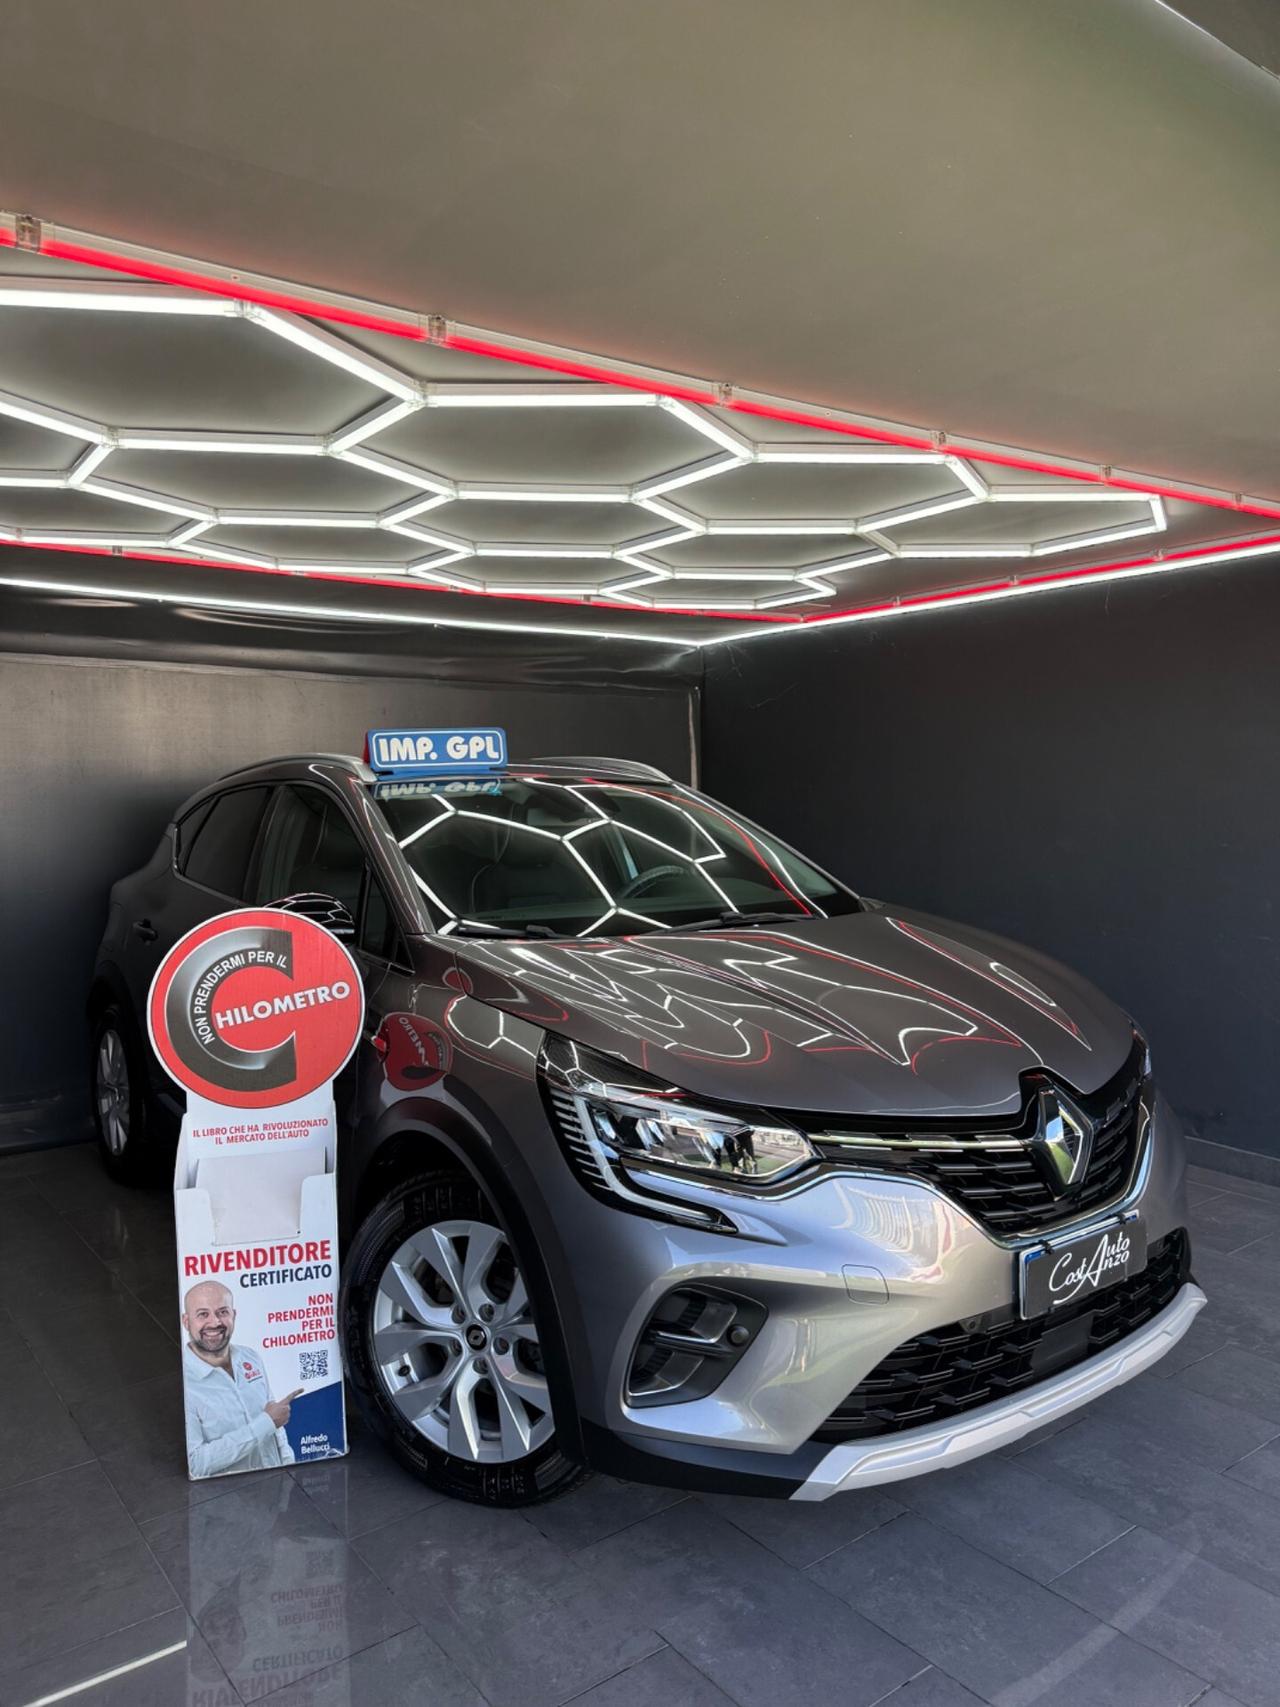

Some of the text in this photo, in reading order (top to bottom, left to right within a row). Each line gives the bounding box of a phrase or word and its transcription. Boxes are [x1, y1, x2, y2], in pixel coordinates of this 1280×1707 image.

[378, 736, 500, 762] IMP. GPL
[194, 951, 288, 1045] NON PRENDERMI PER IL
[193, 1118, 329, 1138] IL LIBRO CHE HA RIVOLUZIONATO
[215, 1129, 310, 1145] IL MERCATO DELL'AUTO
[184, 1240, 331, 1276] RIVENDITORE
[239, 1263, 332, 1289] CERTIFICATO
[308, 1292, 333, 1306] NON
[267, 1305, 334, 1324] PRENDERMI
[302, 1317, 336, 1331] PER IL
[262, 1329, 336, 1349] CHILOMETRO
[301, 1433, 328, 1445] Alfredo
